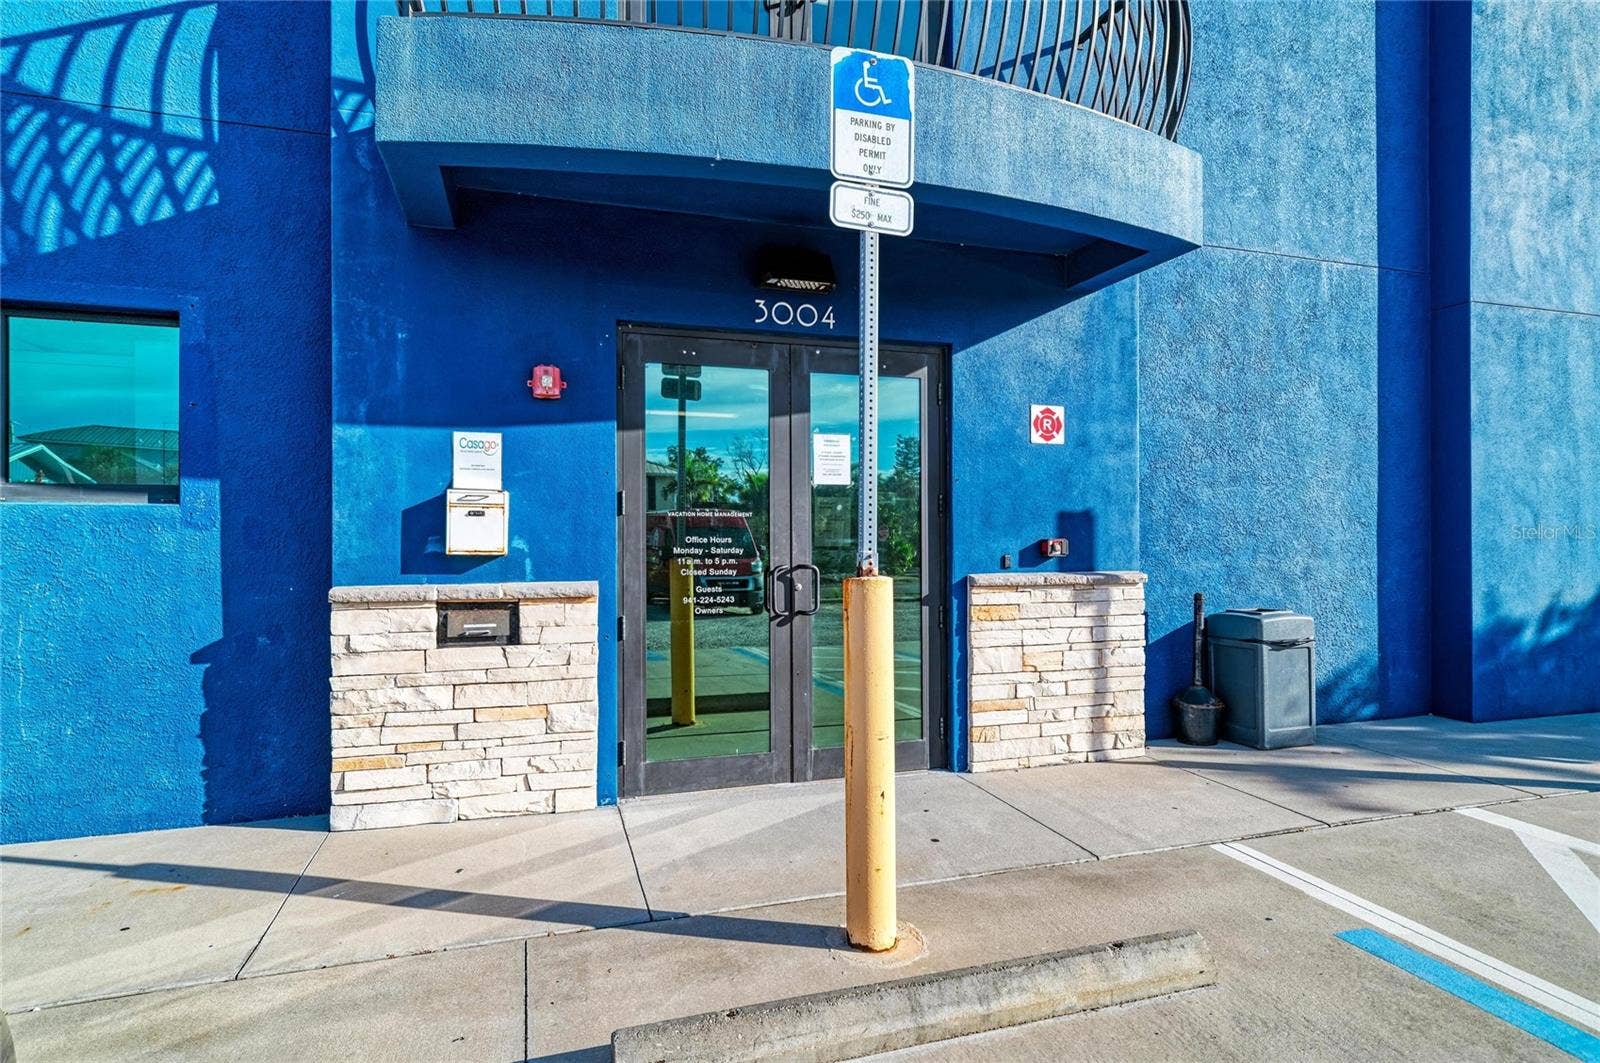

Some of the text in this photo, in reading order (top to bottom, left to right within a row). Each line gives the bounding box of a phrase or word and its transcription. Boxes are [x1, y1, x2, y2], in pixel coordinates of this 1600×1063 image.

[850, 117, 896, 132] PARKING BY
[854, 132, 892, 146] DISABLED
[858, 148, 887, 160] PERMIT
[862, 163, 882, 175] ONLY
[864, 196, 880, 207] FINE
[851, 208, 893, 224] $250 MAX
[754, 299, 836, 330] 3004
[1042, 418, 1054, 431] R
[459, 437, 497, 452] Casago
[685, 536, 732, 544] Office Hours
[673, 547, 703, 556] Monday
[710, 547, 744, 555] Saturday
[721, 558, 738, 566] p.m.
[680, 568, 737, 576] Closed Sunday
[695, 585, 723, 593] Guests
[682, 595, 735, 604] 941-224-5243
[694, 607, 724, 615] Owners
